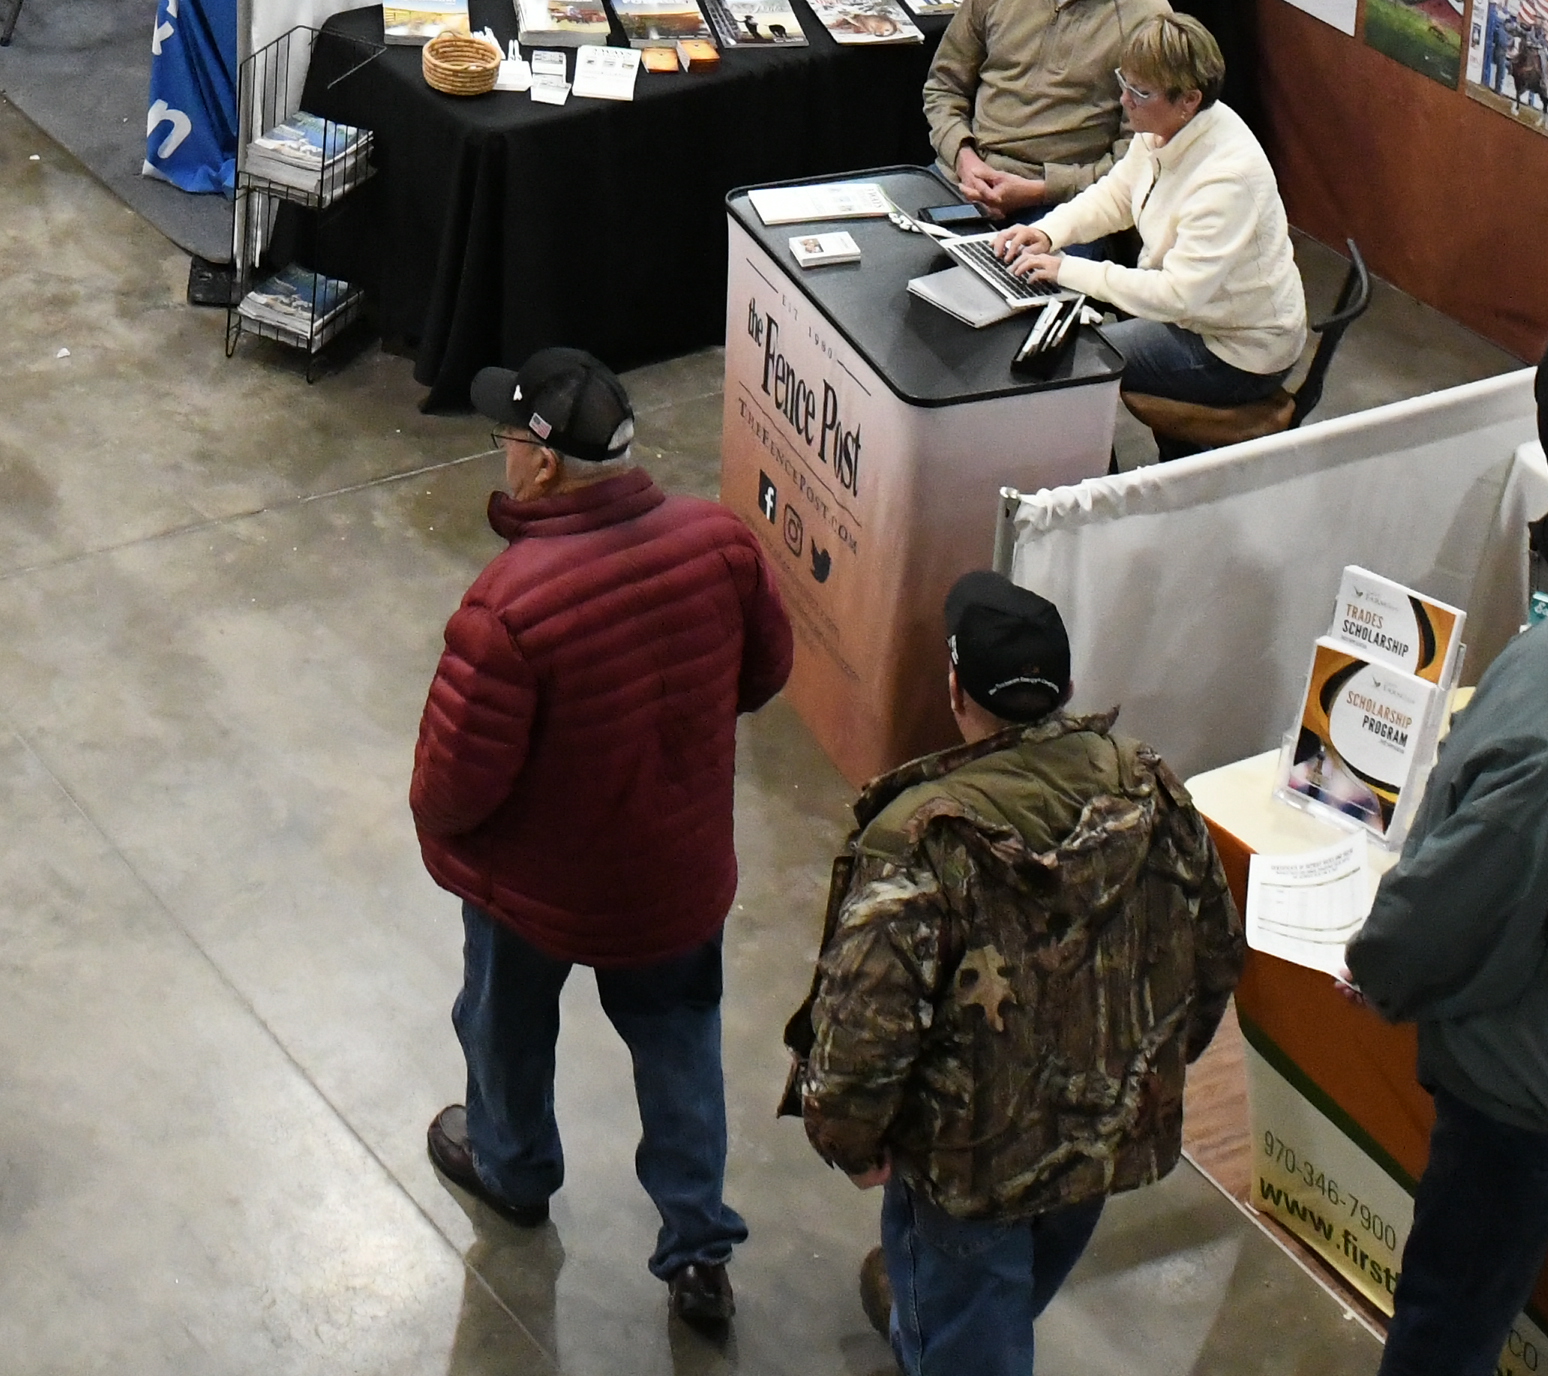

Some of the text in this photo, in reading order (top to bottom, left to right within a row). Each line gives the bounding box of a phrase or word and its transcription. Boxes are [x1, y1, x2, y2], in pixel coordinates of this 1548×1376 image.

[748, 297, 861, 498] the Fence Post
[1342, 619, 1409, 658] SCHOLARSHIP
[1346, 603, 1384, 629] TRADES
[1263, 1130, 1397, 1252] 970-346-7900
